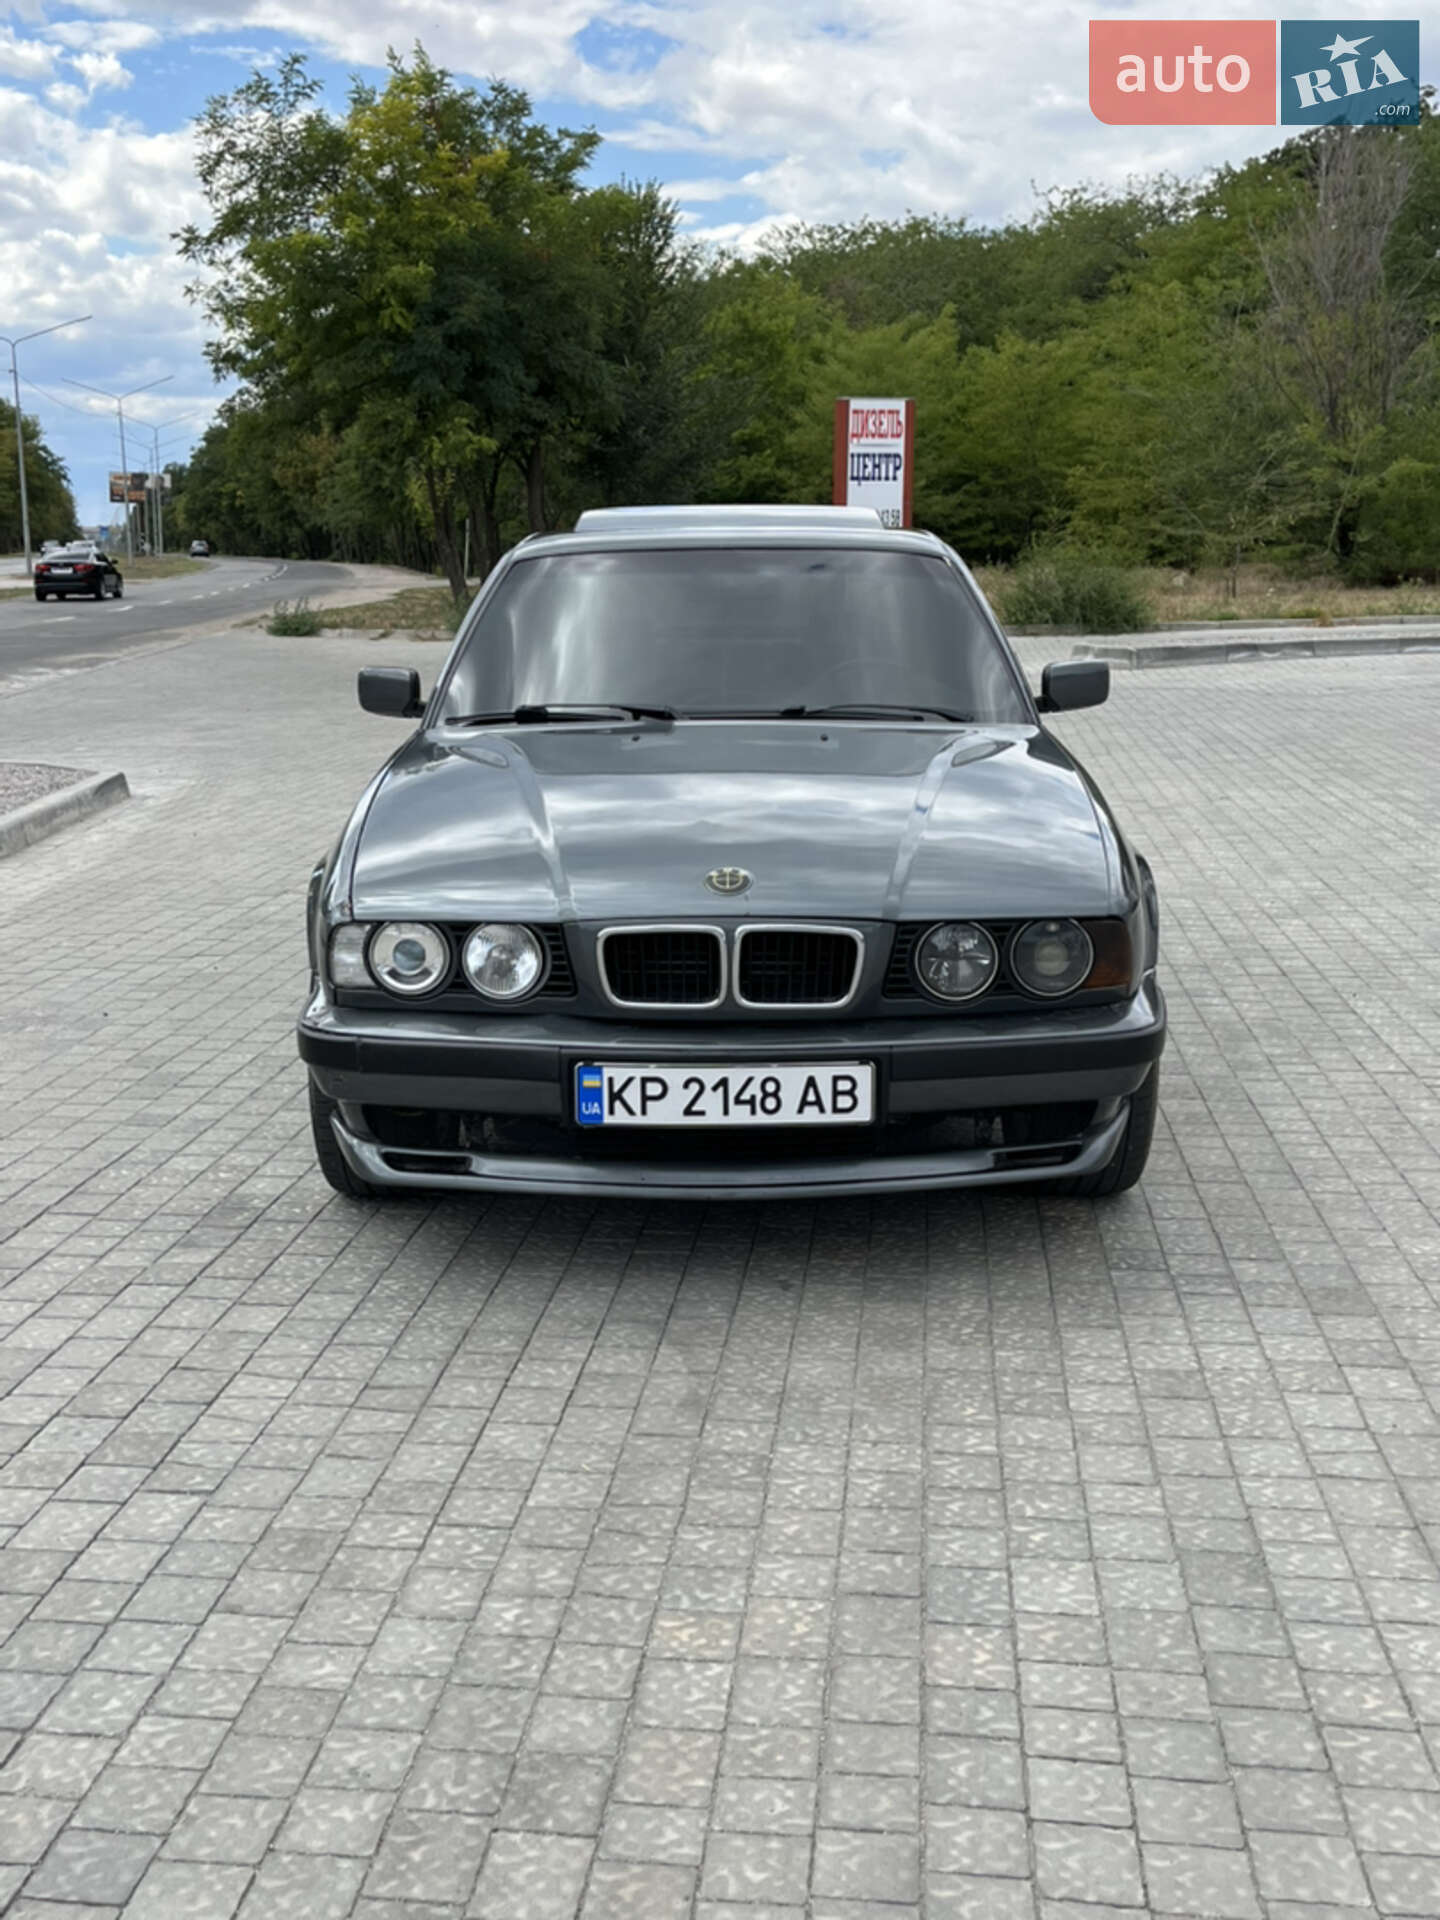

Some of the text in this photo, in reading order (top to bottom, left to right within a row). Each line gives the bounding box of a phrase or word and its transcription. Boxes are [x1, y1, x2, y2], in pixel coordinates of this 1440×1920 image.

[851, 409, 903, 443] ДИЗЕЛЬ
[850, 452, 902, 486] ЦЕНТР
[583, 1102, 600, 1114] UA
[607, 1075, 858, 1116] KP 2148 AB
